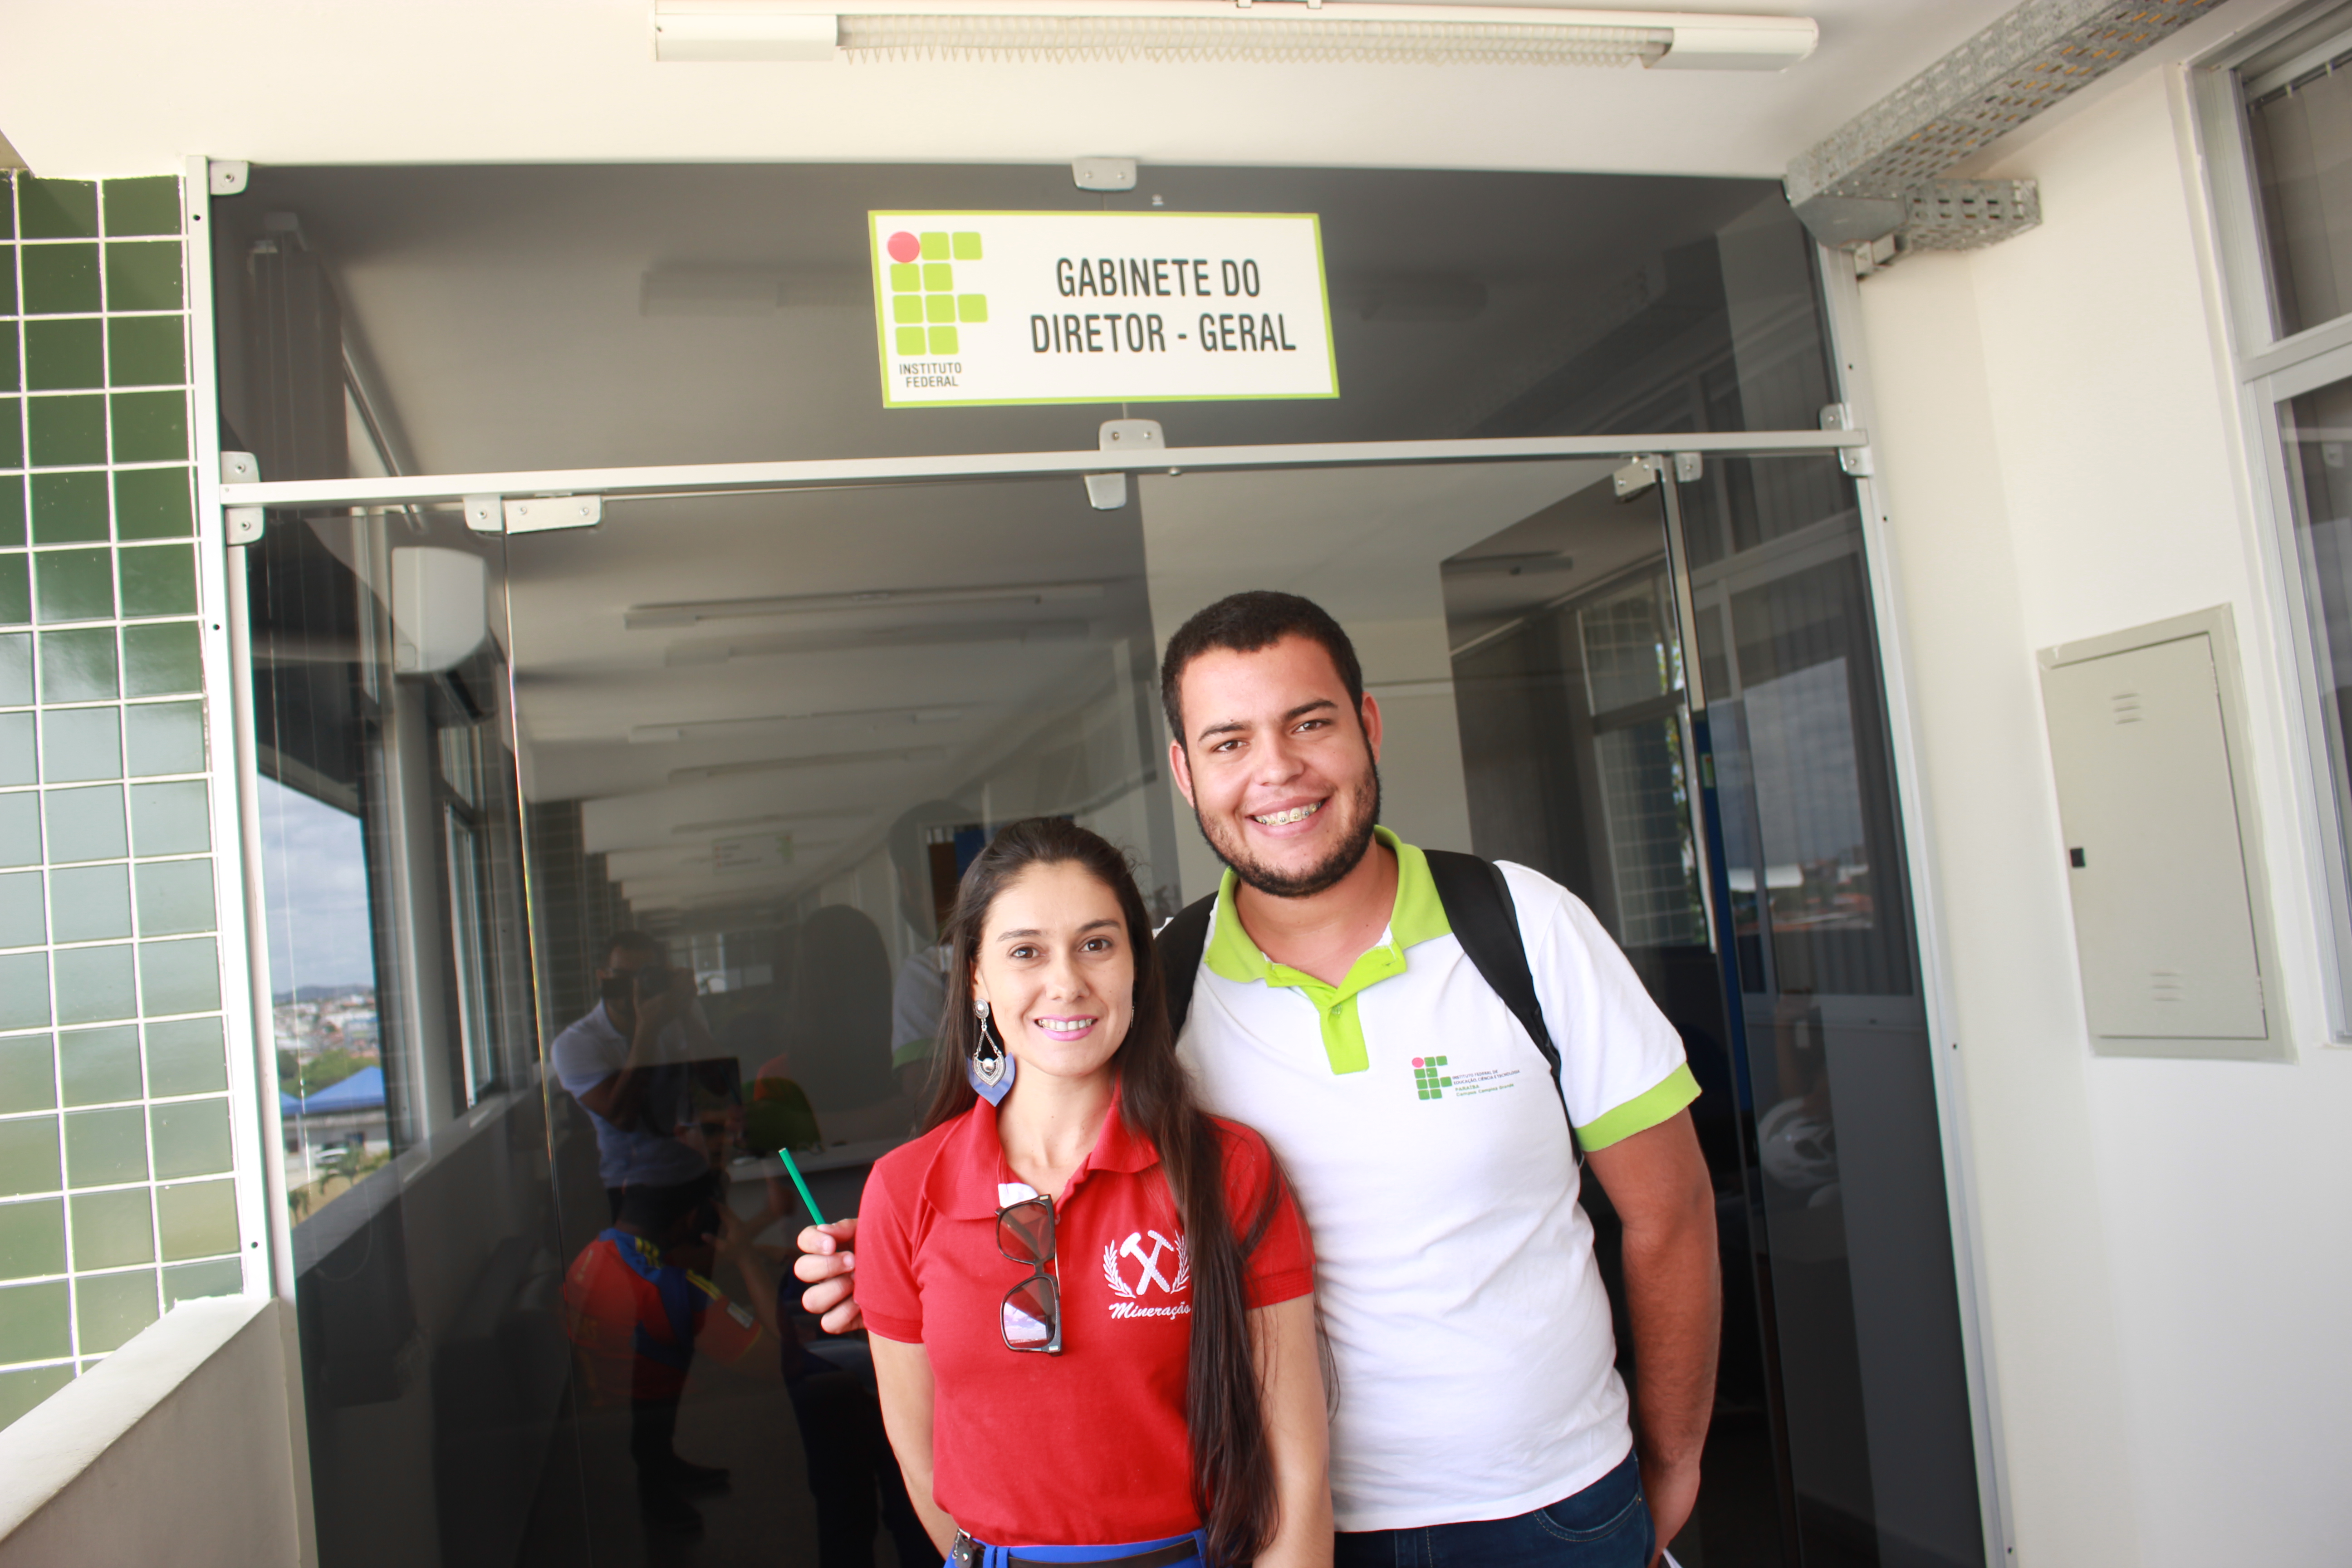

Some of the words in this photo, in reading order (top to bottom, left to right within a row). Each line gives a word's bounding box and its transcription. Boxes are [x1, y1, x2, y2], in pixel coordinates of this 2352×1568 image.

[1056, 258, 1211, 297] GABINETE
[1221, 259, 1260, 297] DO
[1030, 313, 1166, 353] DIRETOR
[1199, 313, 1296, 351] GERAL
[899, 362, 962, 375] INSTITUTO
[906, 376, 959, 387] FEDERAL
[1108, 1302, 1191, 1320] Mineração
